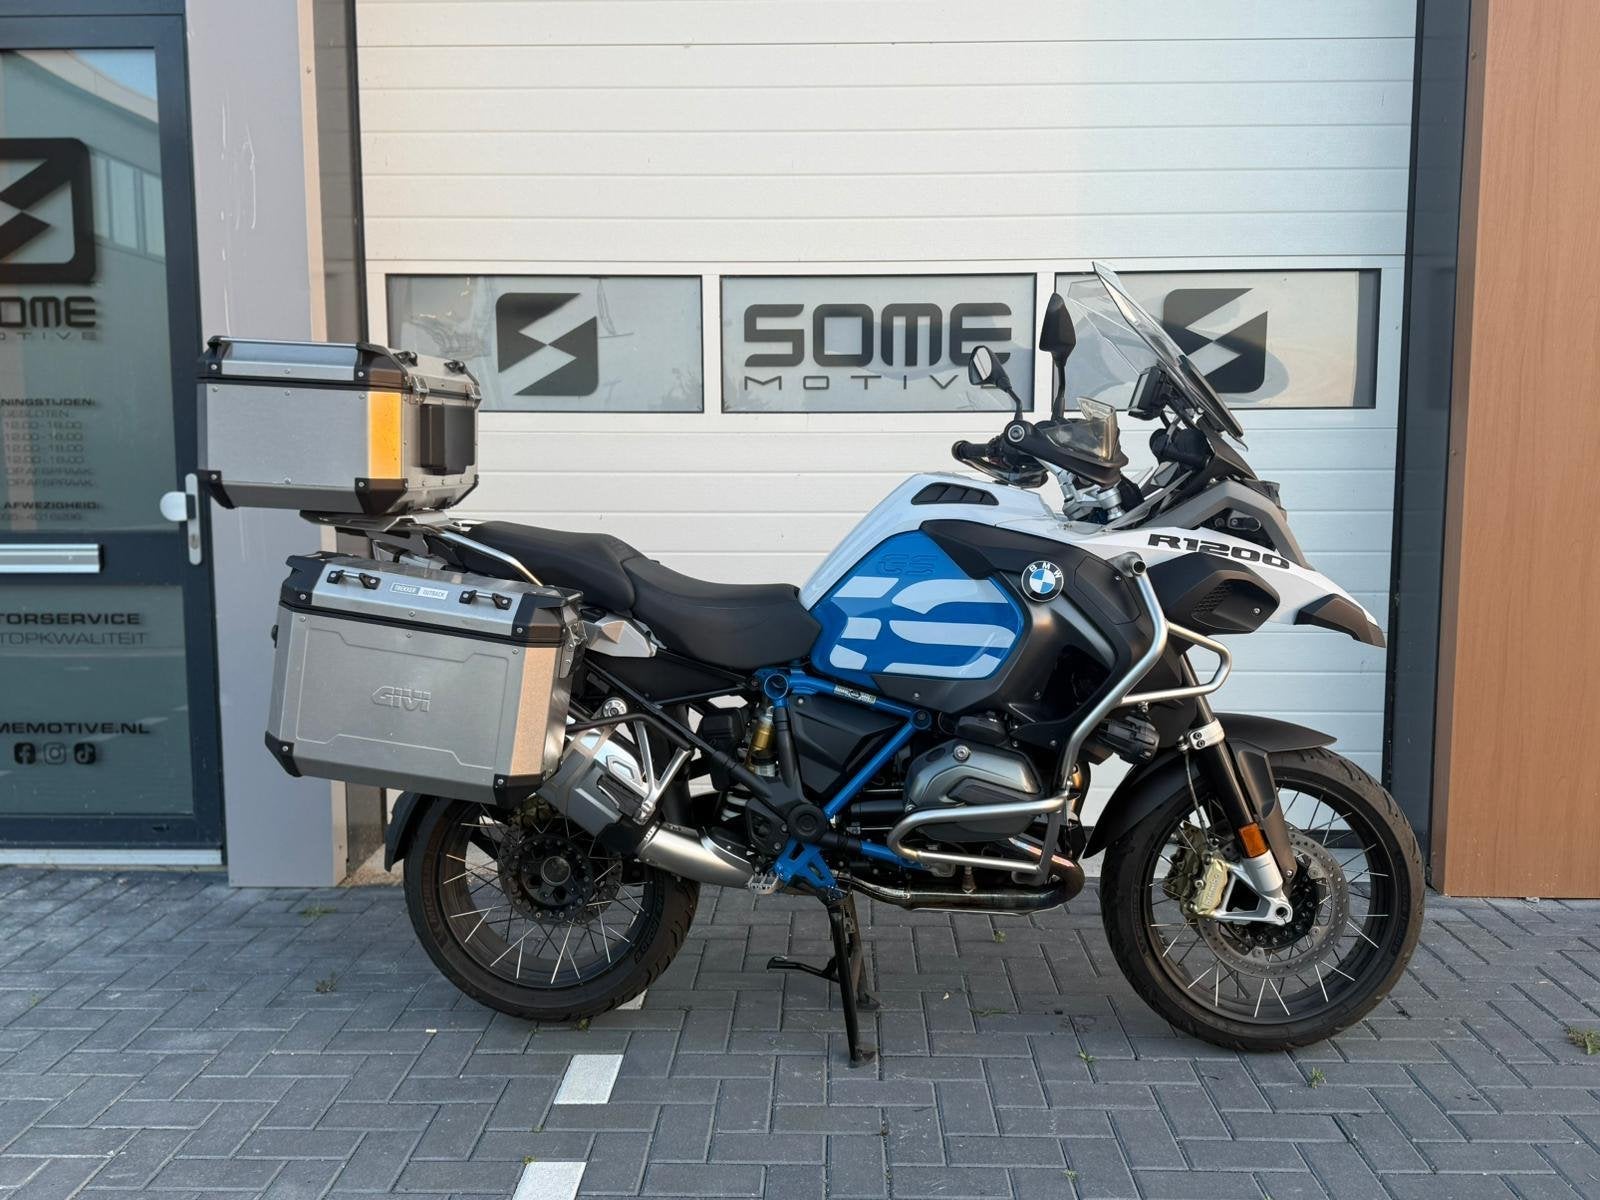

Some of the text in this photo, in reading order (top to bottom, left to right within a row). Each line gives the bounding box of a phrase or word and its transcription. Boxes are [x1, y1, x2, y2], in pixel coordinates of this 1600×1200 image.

[744, 303, 1012, 368] SOME
[744, 374, 998, 391] MOTIV
[1148, 533, 1290, 570] R1200
[1028, 561, 1062, 579] BMW
[371, 685, 431, 712] GIVI
